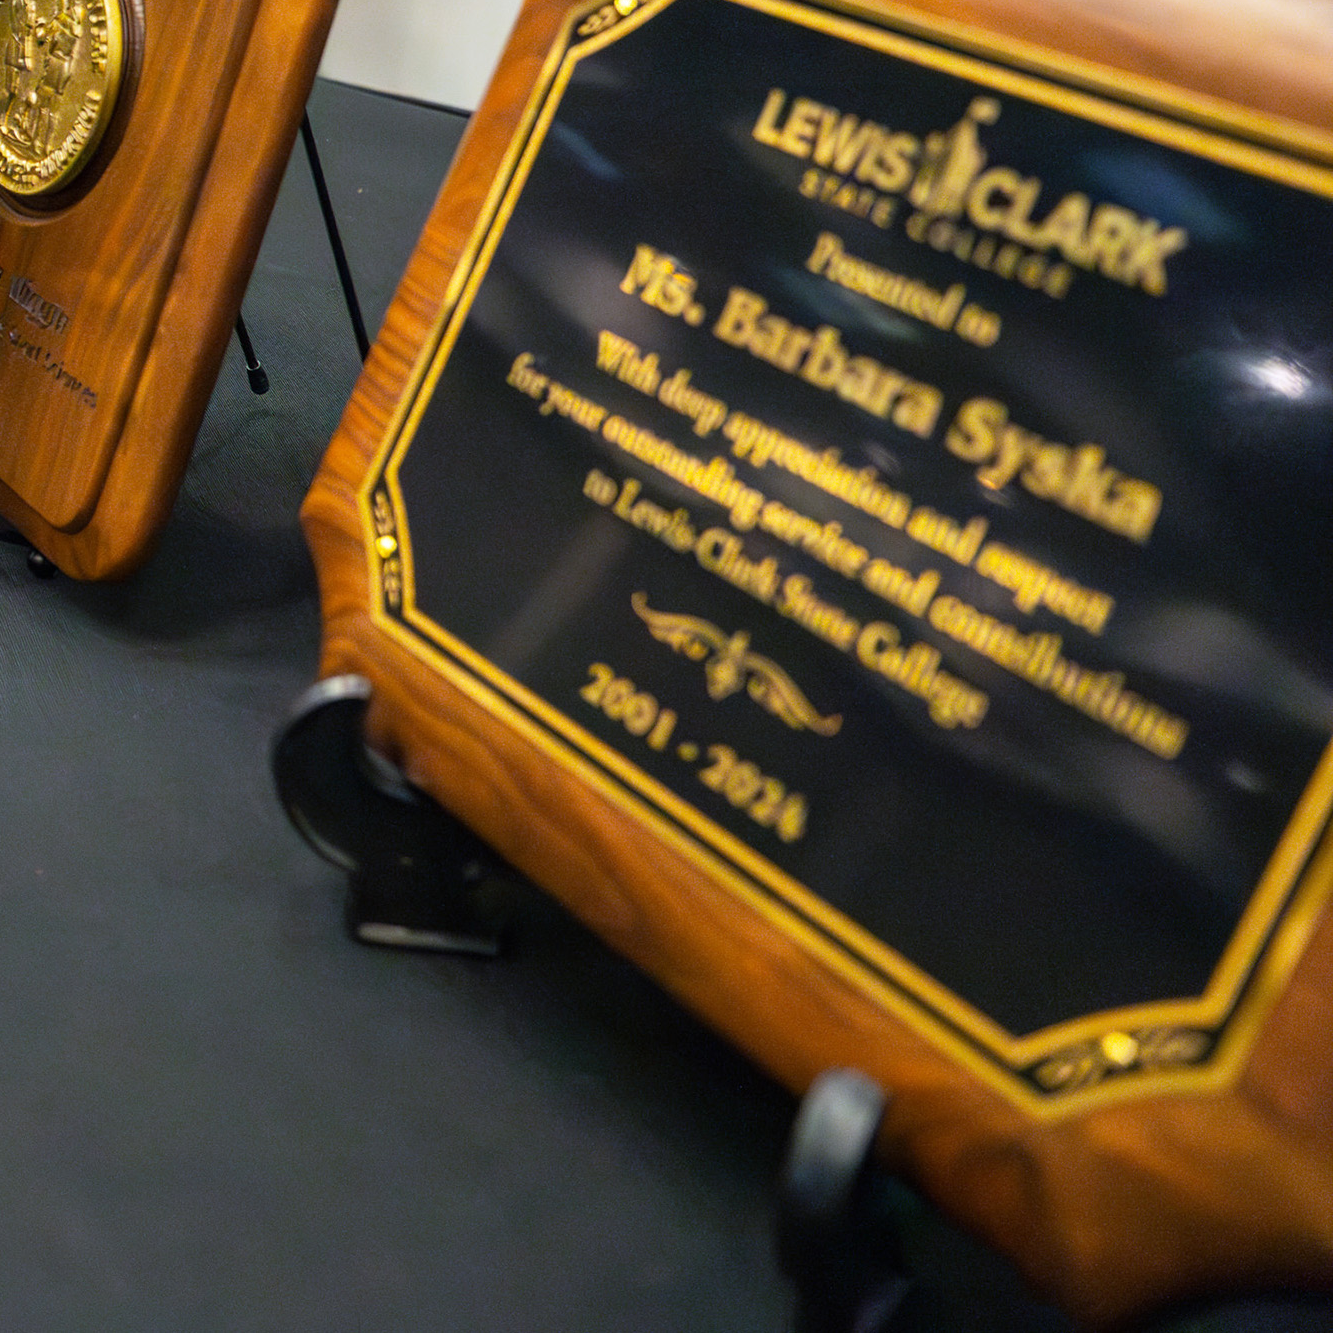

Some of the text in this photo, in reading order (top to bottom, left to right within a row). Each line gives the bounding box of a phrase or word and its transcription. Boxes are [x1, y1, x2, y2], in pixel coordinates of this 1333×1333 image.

[752, 87, 1189, 298] LEWIS CLARK
[506, 352, 551, 400] for
[538, 381, 609, 433] your
[861, 557, 941, 619] and
[597, 329, 661, 397] With
[905, 504, 990, 566] and
[619, 243, 1163, 544] Ms. Barbara Syska
[579, 662, 678, 752] 2001
[696, 743, 808, 844] 2024
[856, 620, 990, 730] College
